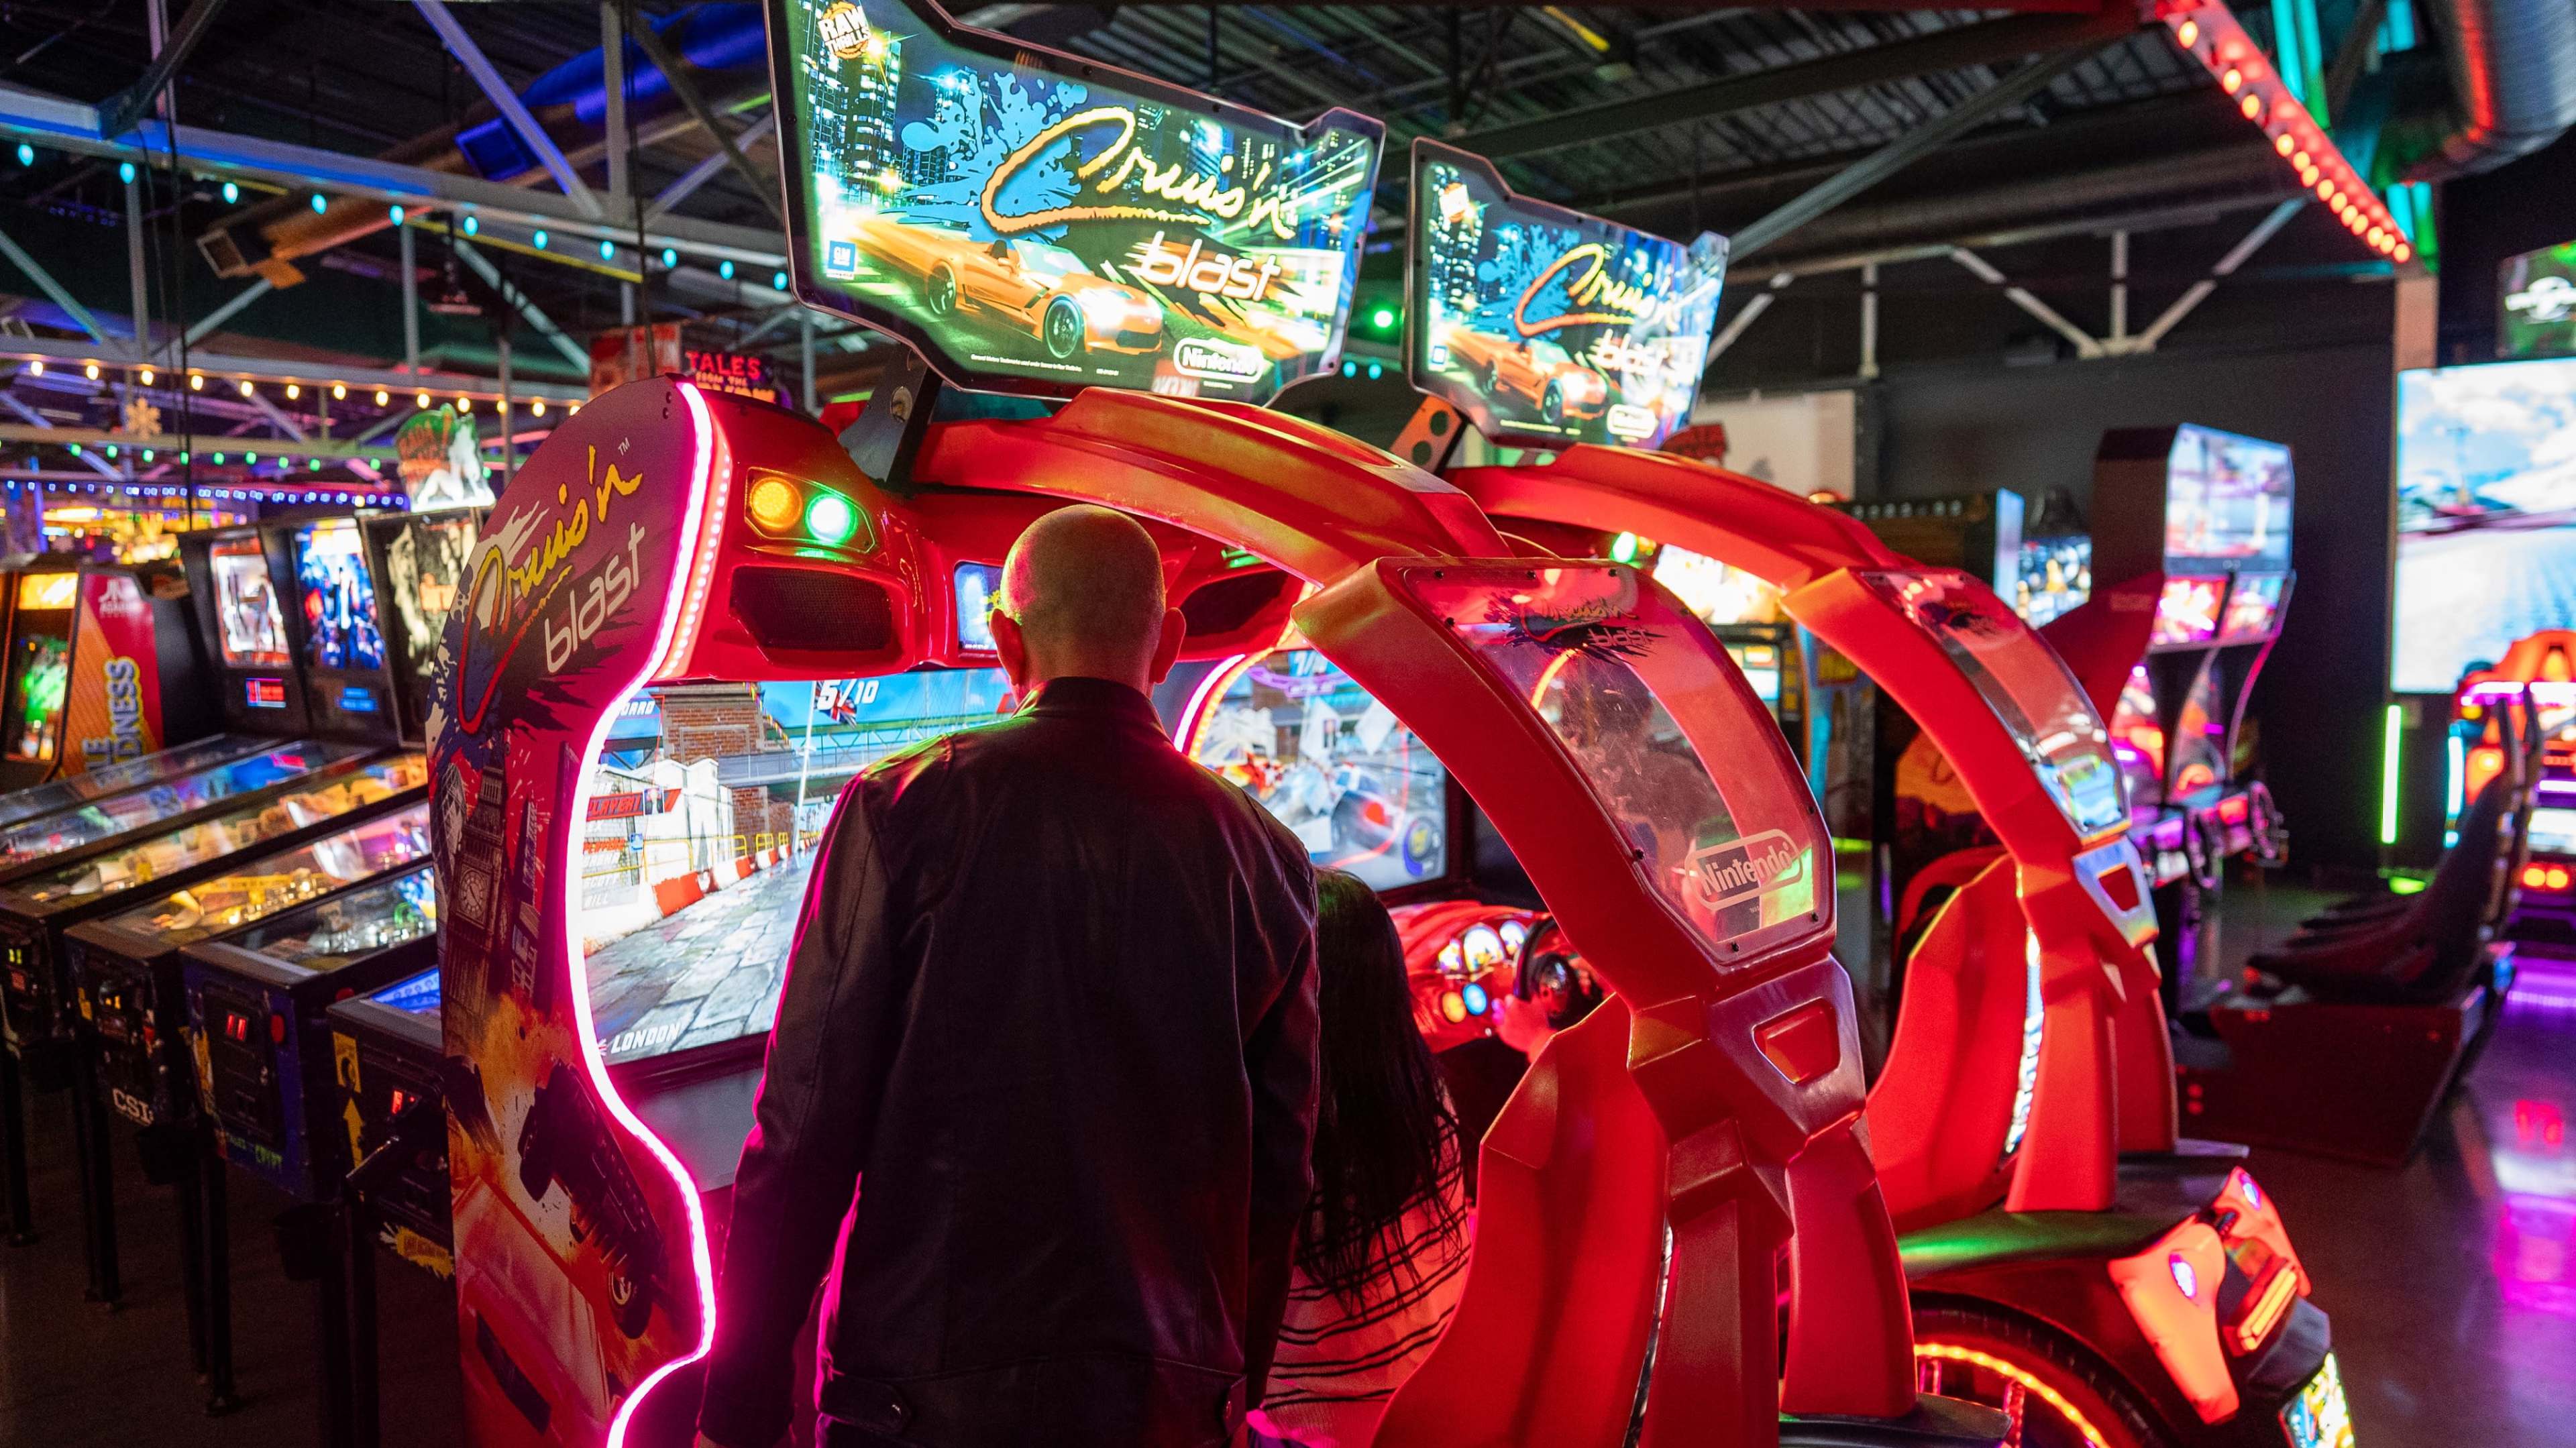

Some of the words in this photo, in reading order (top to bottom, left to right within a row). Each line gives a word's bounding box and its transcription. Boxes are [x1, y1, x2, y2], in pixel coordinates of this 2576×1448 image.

[818, 5, 869, 42] RAW
[980, 106, 1295, 239] Cruis'n
[1134, 230, 1282, 302] blast
[686, 350, 761, 380] TALES
[1182, 345, 1259, 376] Nintendo
[457, 444, 643, 736] Cruis'n
[543, 522, 645, 673] blast
[817, 678, 880, 710] 5/10
[1701, 844, 1792, 897] Nintendo
[610, 1021, 682, 1055] LONDON
